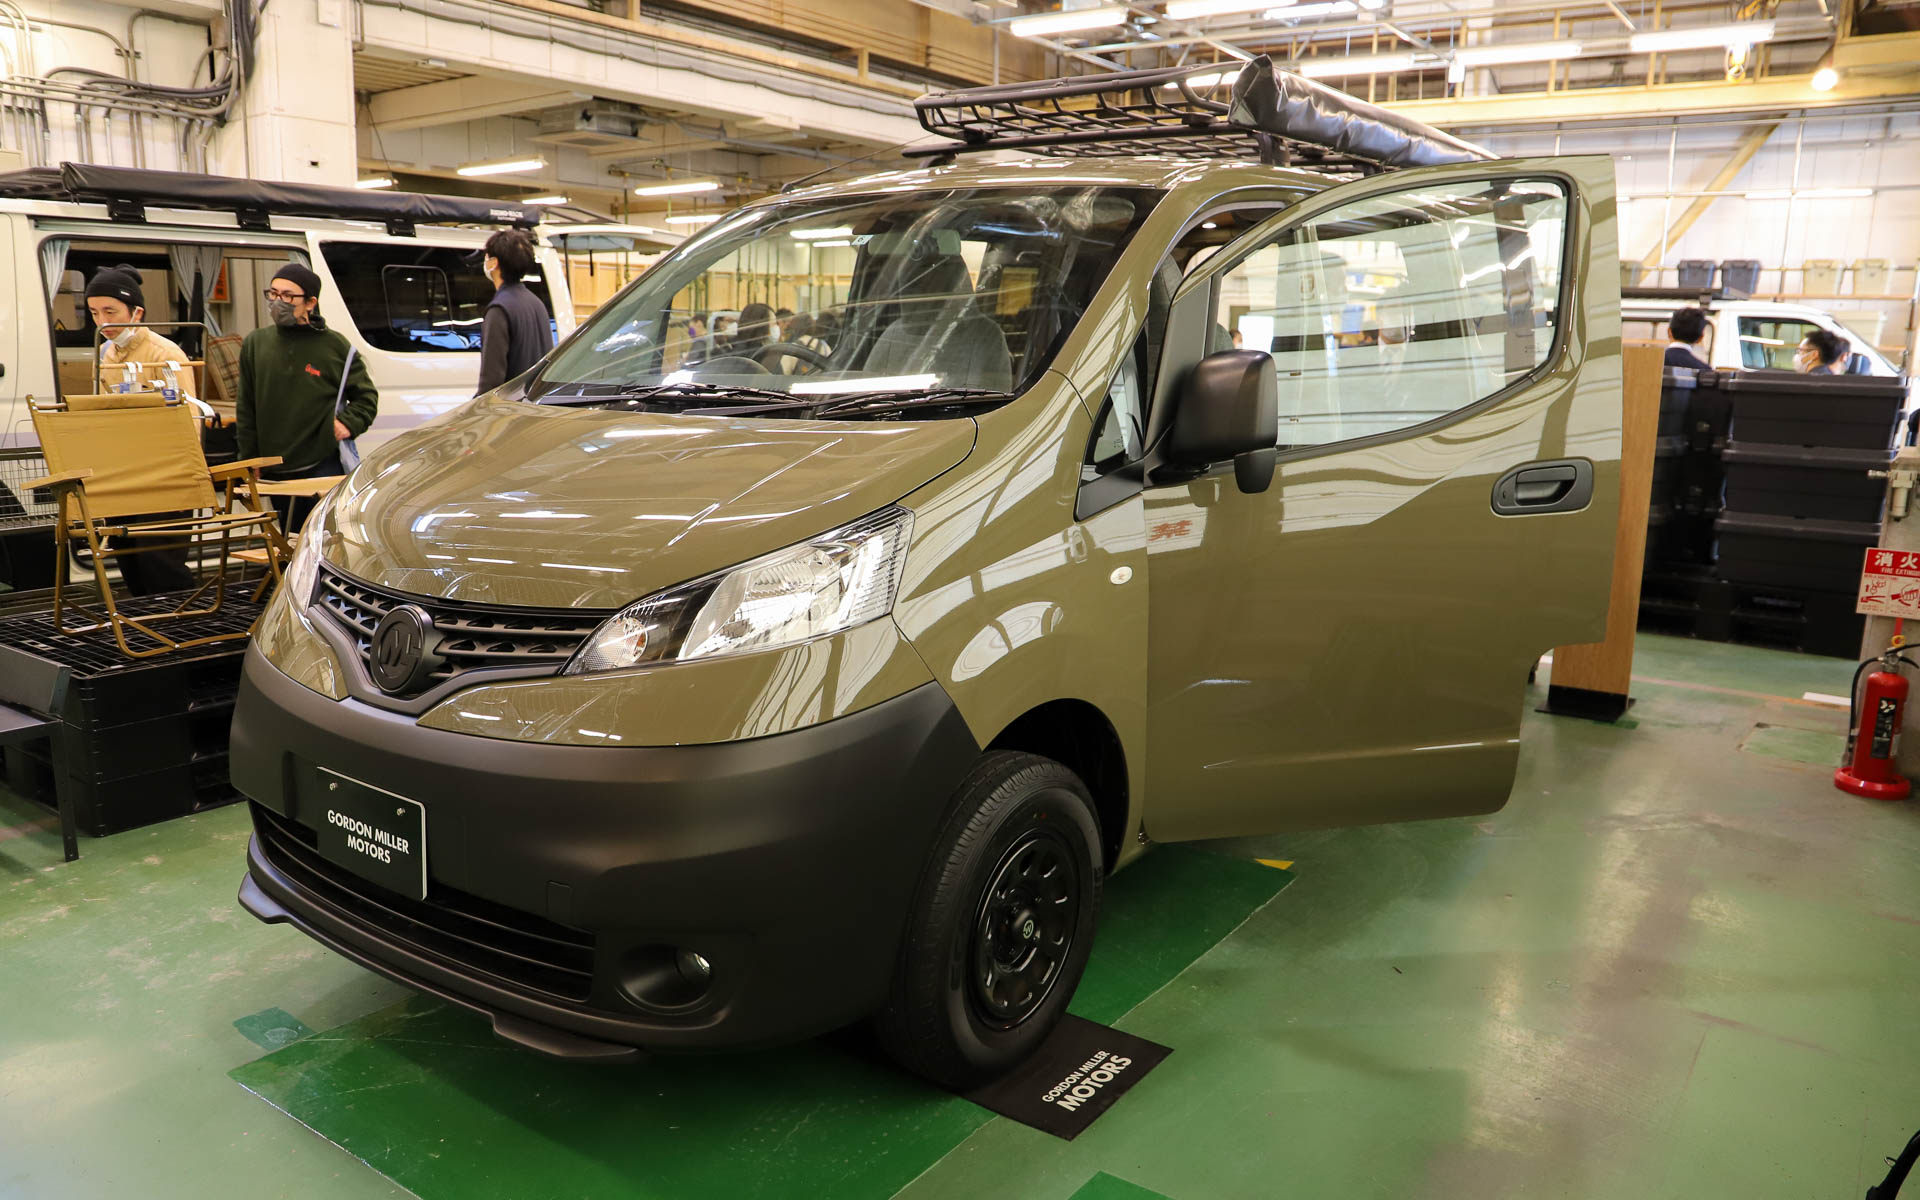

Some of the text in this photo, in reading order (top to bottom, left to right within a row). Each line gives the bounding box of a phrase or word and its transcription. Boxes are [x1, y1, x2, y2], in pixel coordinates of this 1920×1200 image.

[1874, 552, 1919, 569] 消火
[327, 809, 410, 855] GORDON MILLER
[347, 834, 391, 864] MOTORS
[1042, 1050, 1111, 1102] GORDON MILLER
[1056, 1054, 1132, 1112] MOTORS
